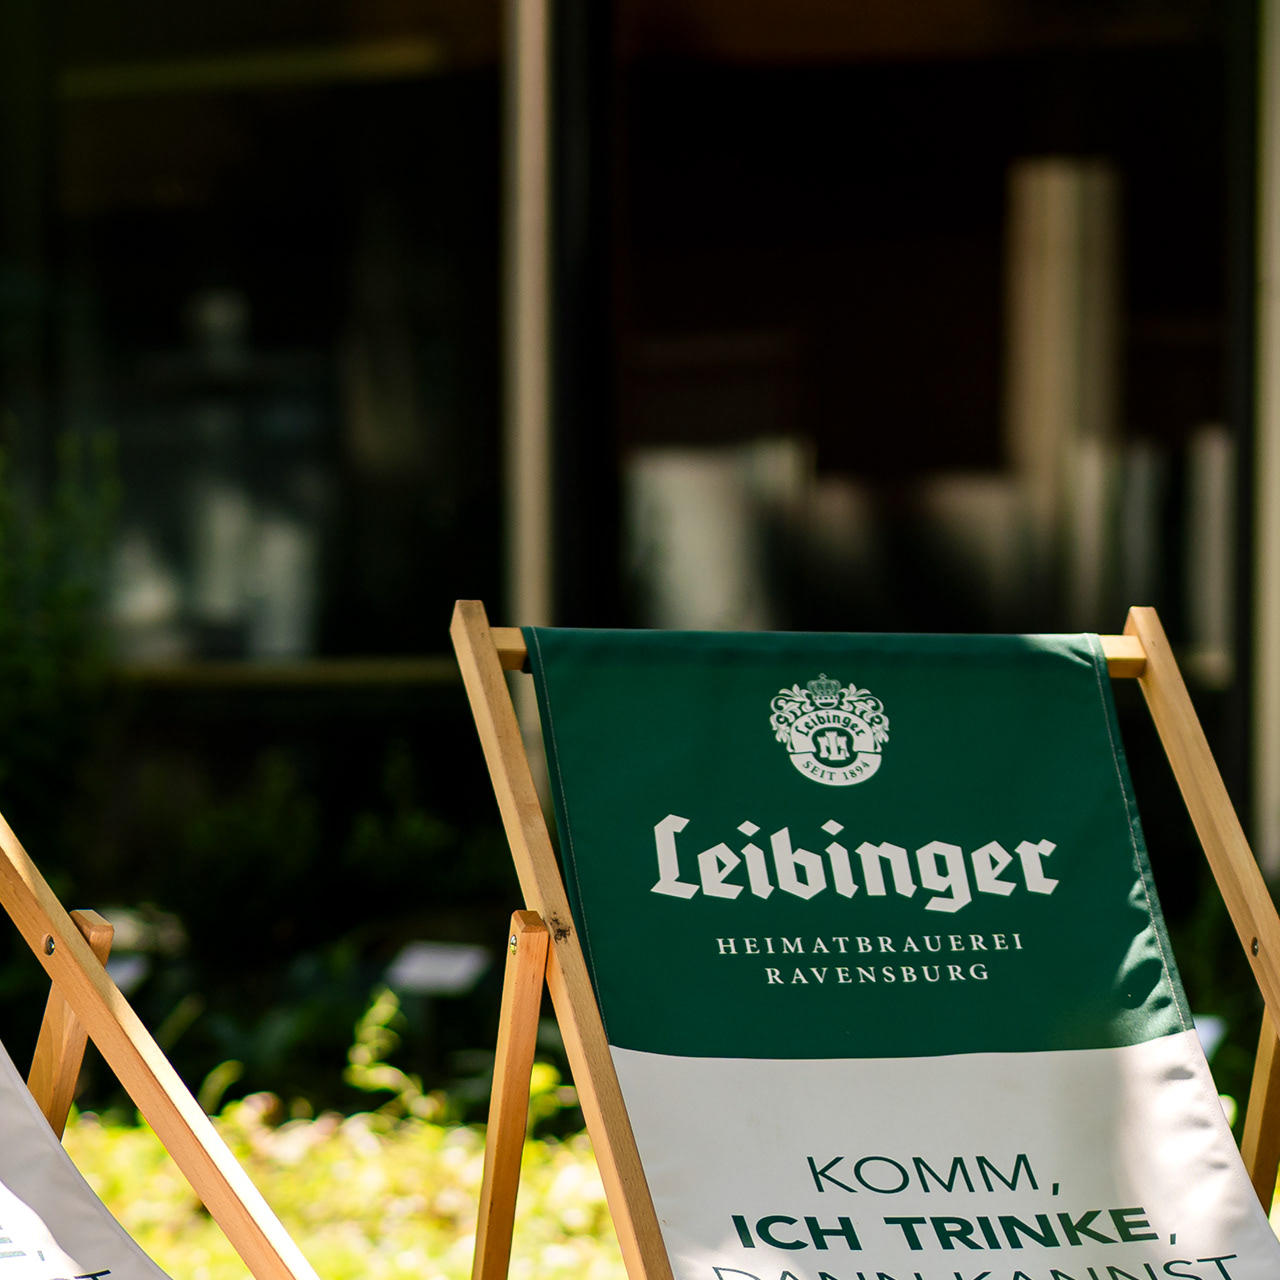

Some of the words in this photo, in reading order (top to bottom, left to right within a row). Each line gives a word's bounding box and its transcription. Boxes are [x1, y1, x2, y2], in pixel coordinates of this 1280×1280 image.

[794, 711, 866, 737] Leibinger
[802, 760, 836, 781] SEIT
[842, 760, 870, 780] 1894
[650, 813, 1060, 913] Leibinger
[716, 933, 1024, 955] HEIMATBRAUEREI
[764, 963, 989, 985] RAVENSBURG
[806, 1153, 1061, 1197] KOMM,
[730, 1214, 863, 1250] ICH
[883, 1206, 1177, 1250] TRINKE,
